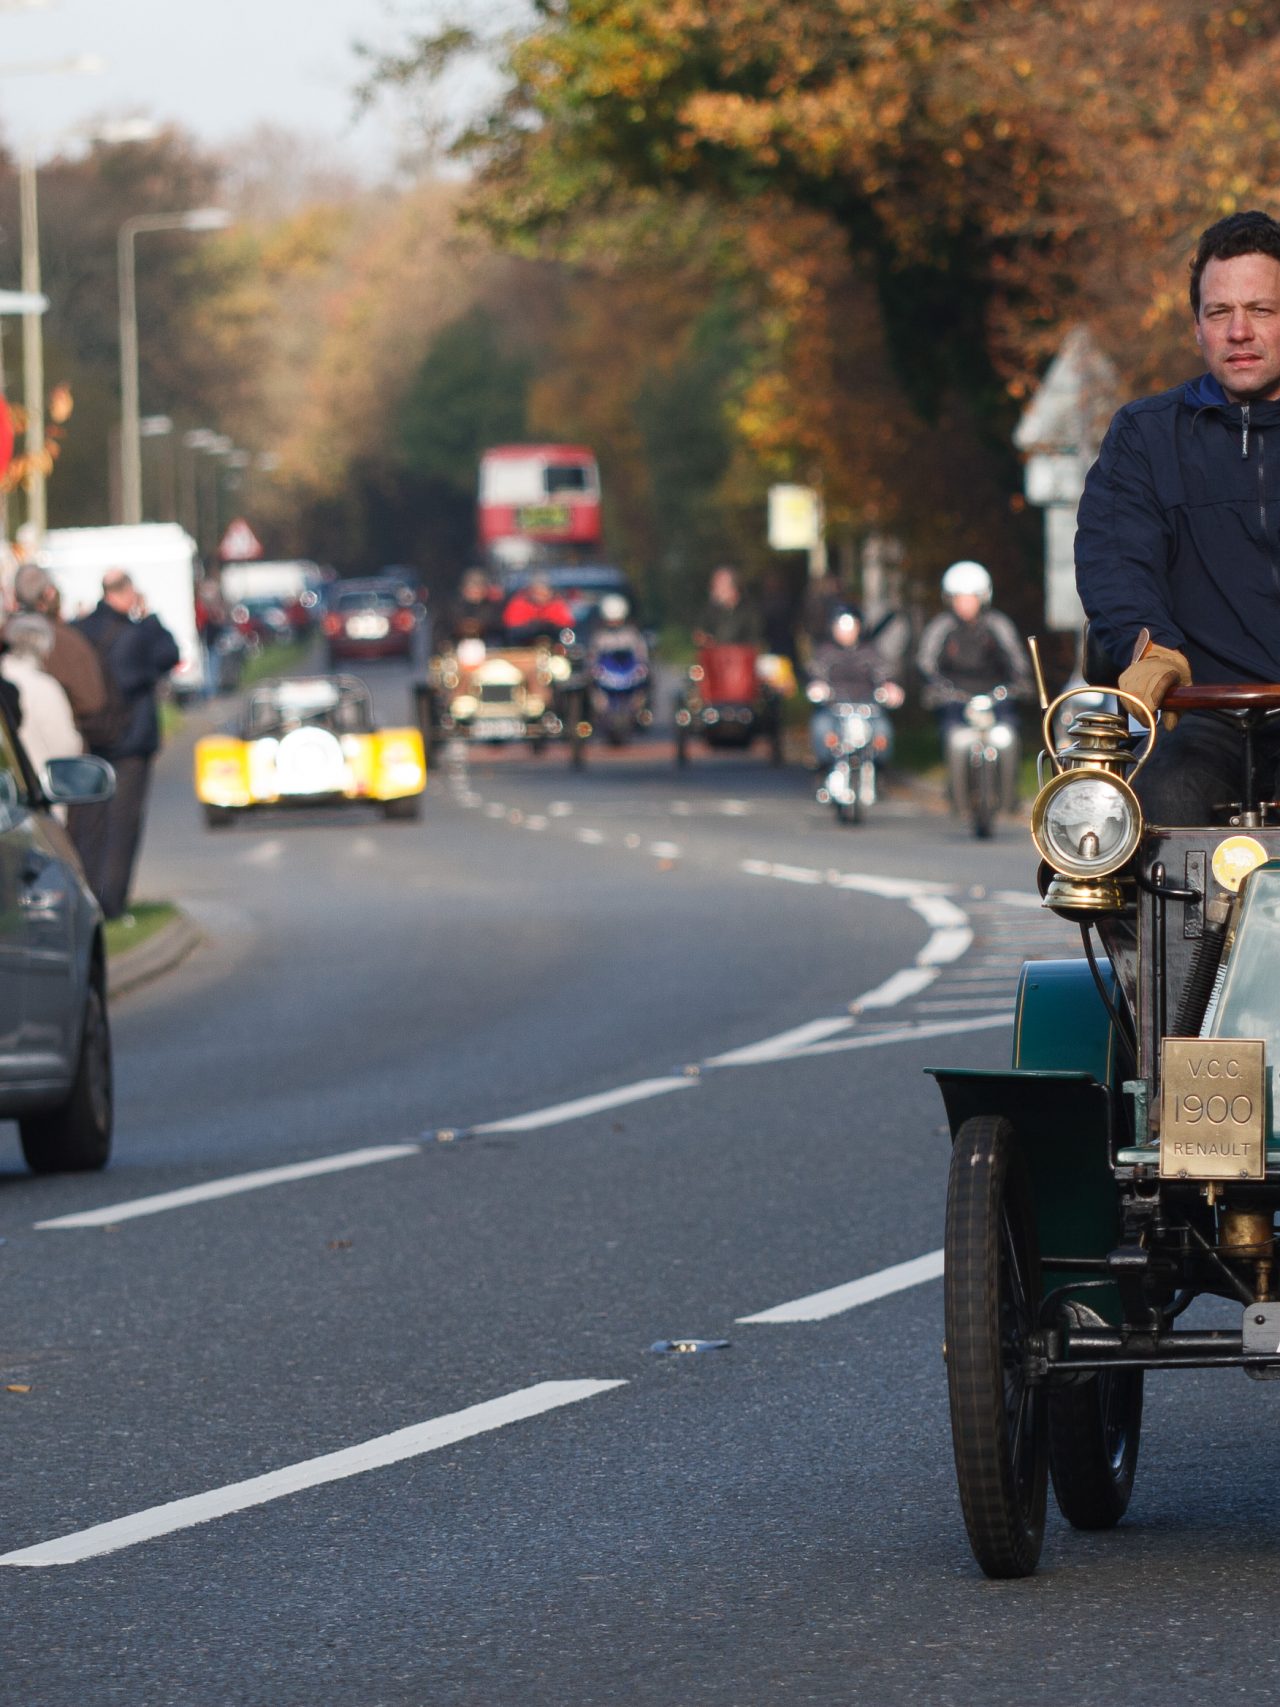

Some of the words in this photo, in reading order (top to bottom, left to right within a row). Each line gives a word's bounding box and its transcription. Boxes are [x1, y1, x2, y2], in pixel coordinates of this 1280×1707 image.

[1188, 1059, 1244, 1079] V.C.C.
[1174, 1094, 1253, 1126] 1900
[1174, 1142, 1251, 1157] RENAULT
